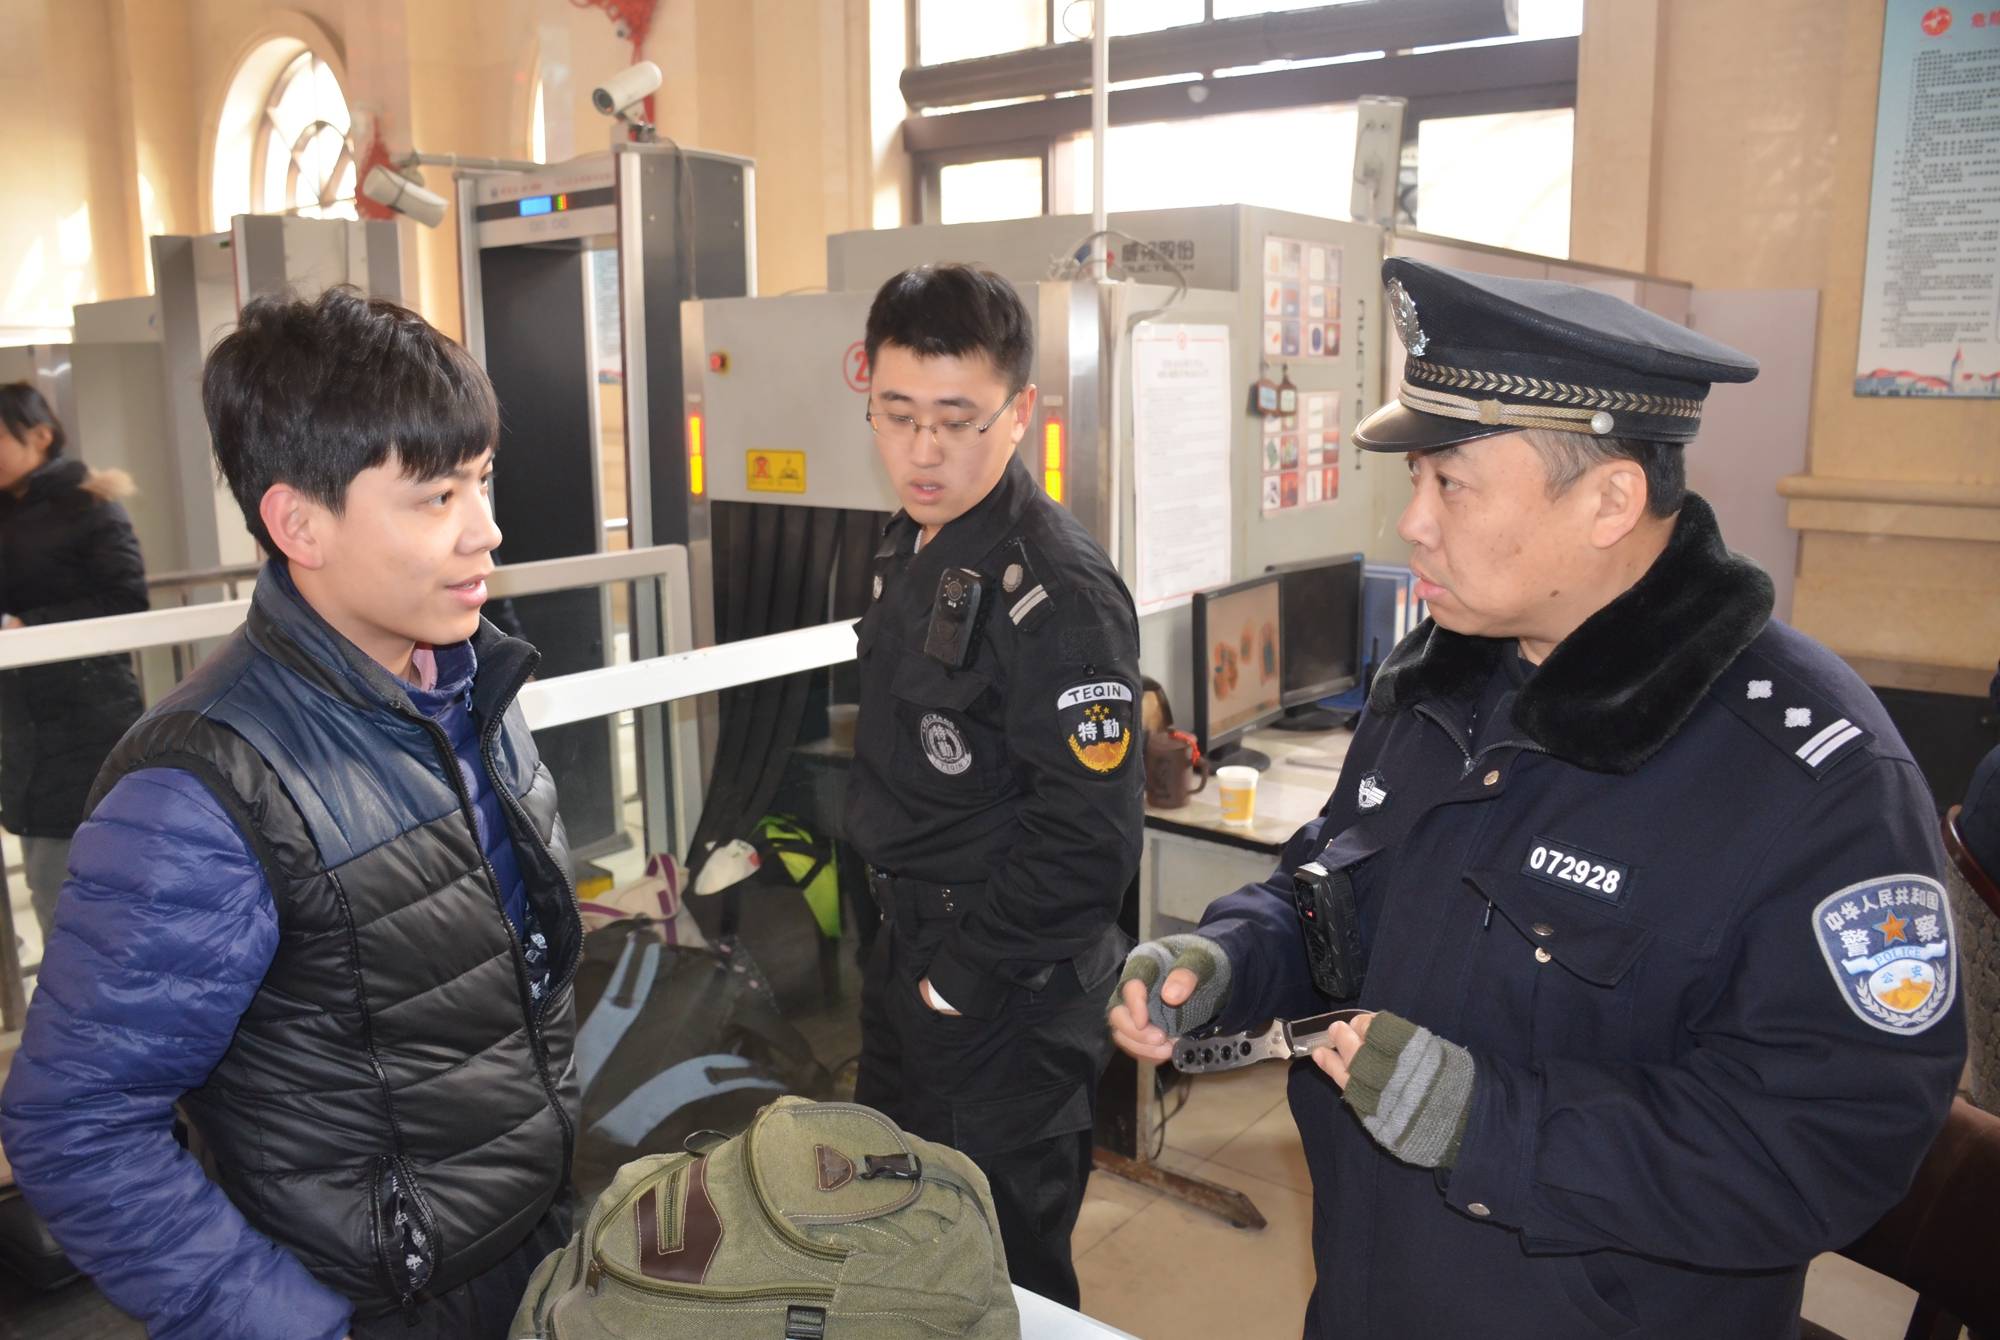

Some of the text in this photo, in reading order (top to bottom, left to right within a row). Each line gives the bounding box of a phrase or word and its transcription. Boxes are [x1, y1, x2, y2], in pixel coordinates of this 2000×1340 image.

[854, 350, 869, 383] 2
[1068, 684, 1121, 703] TEQIN
[1077, 718, 1120, 743] 特勤
[940, 761, 964, 772] TEQIN
[1530, 846, 1621, 894] 072928
[1824, 886, 1940, 931] 中华人民共和国
[1875, 947, 1921, 966] POLICE
